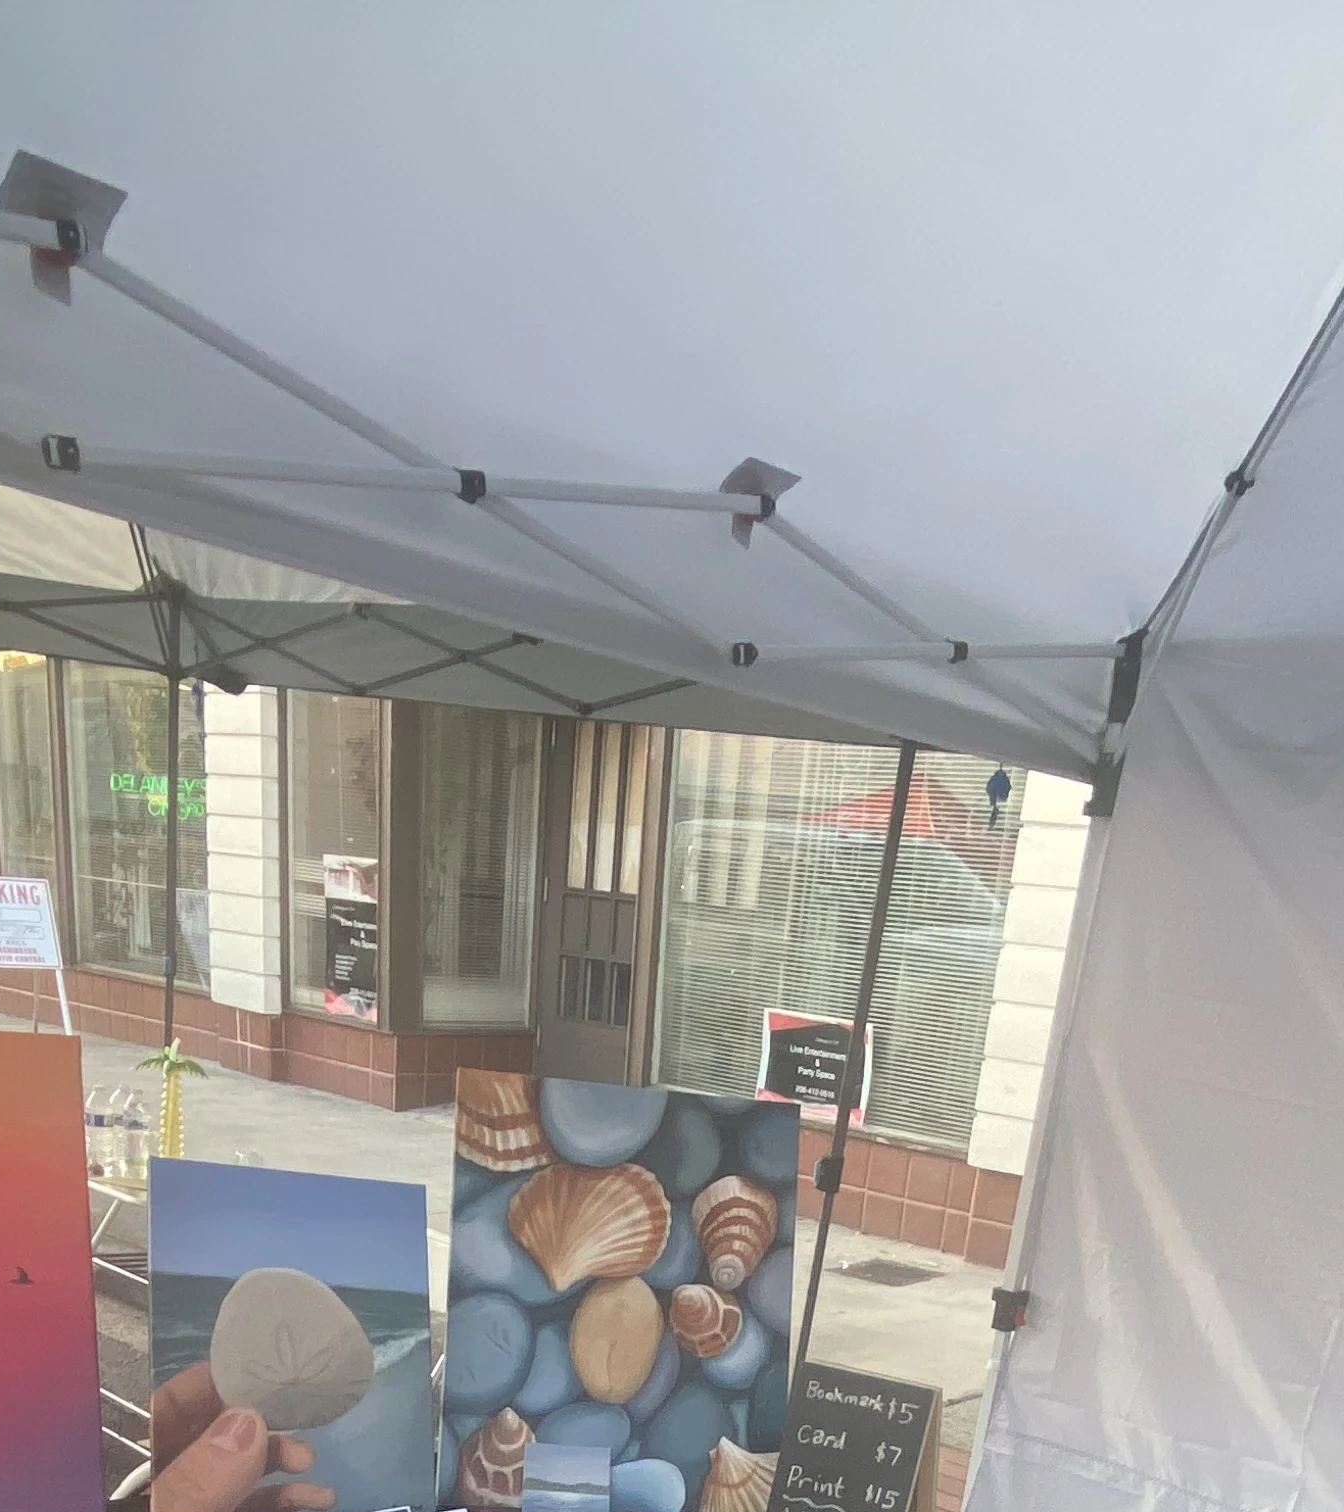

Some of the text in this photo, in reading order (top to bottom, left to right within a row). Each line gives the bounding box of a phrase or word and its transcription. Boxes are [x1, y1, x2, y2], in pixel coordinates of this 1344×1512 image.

[797, 1066, 816, 1078] Party
[806, 1380, 920, 1424] Bookmark $5
[797, 1424, 902, 1466] Card $7
[786, 1465, 900, 1509] Print $15
